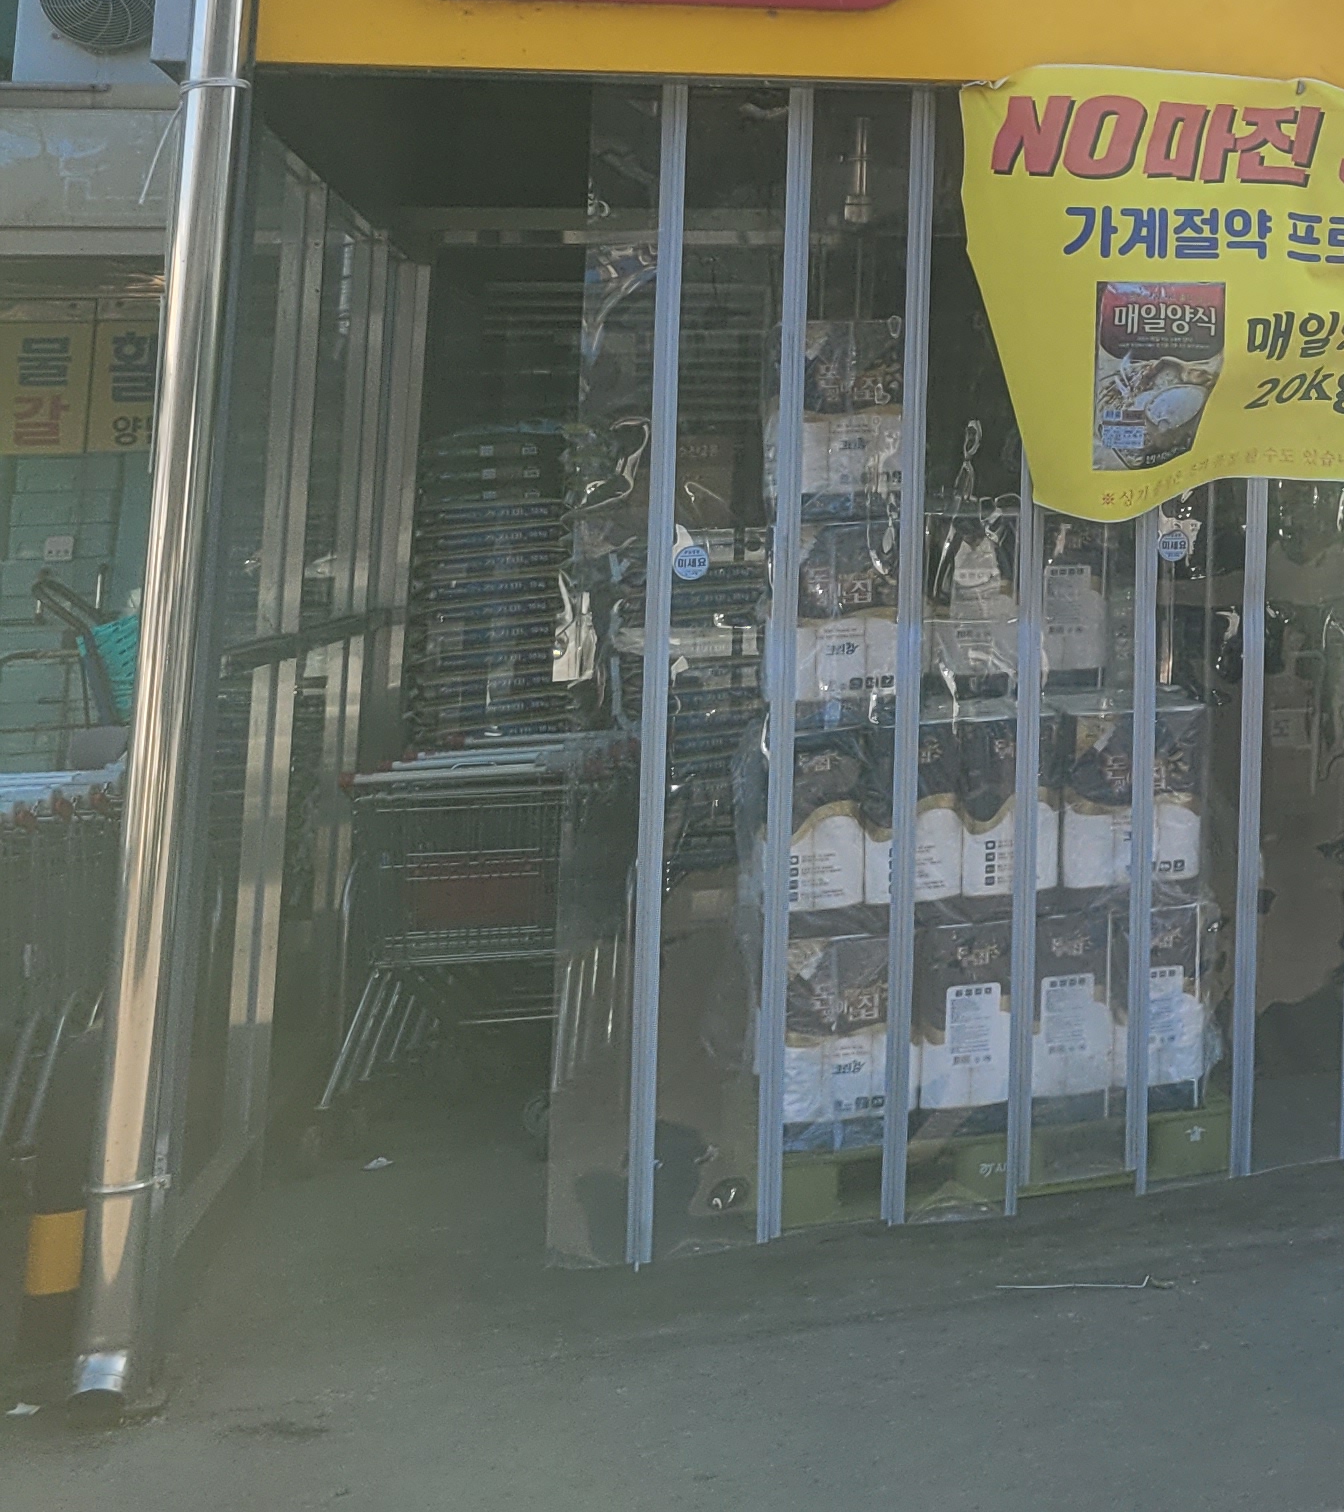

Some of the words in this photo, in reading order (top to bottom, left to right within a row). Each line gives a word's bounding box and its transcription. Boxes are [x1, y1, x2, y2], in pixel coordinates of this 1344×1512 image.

[991, 95, 1326, 188] NO마진
[1062, 205, 1273, 261] 가계절약
[1112, 303, 1218, 337] 매일양식
